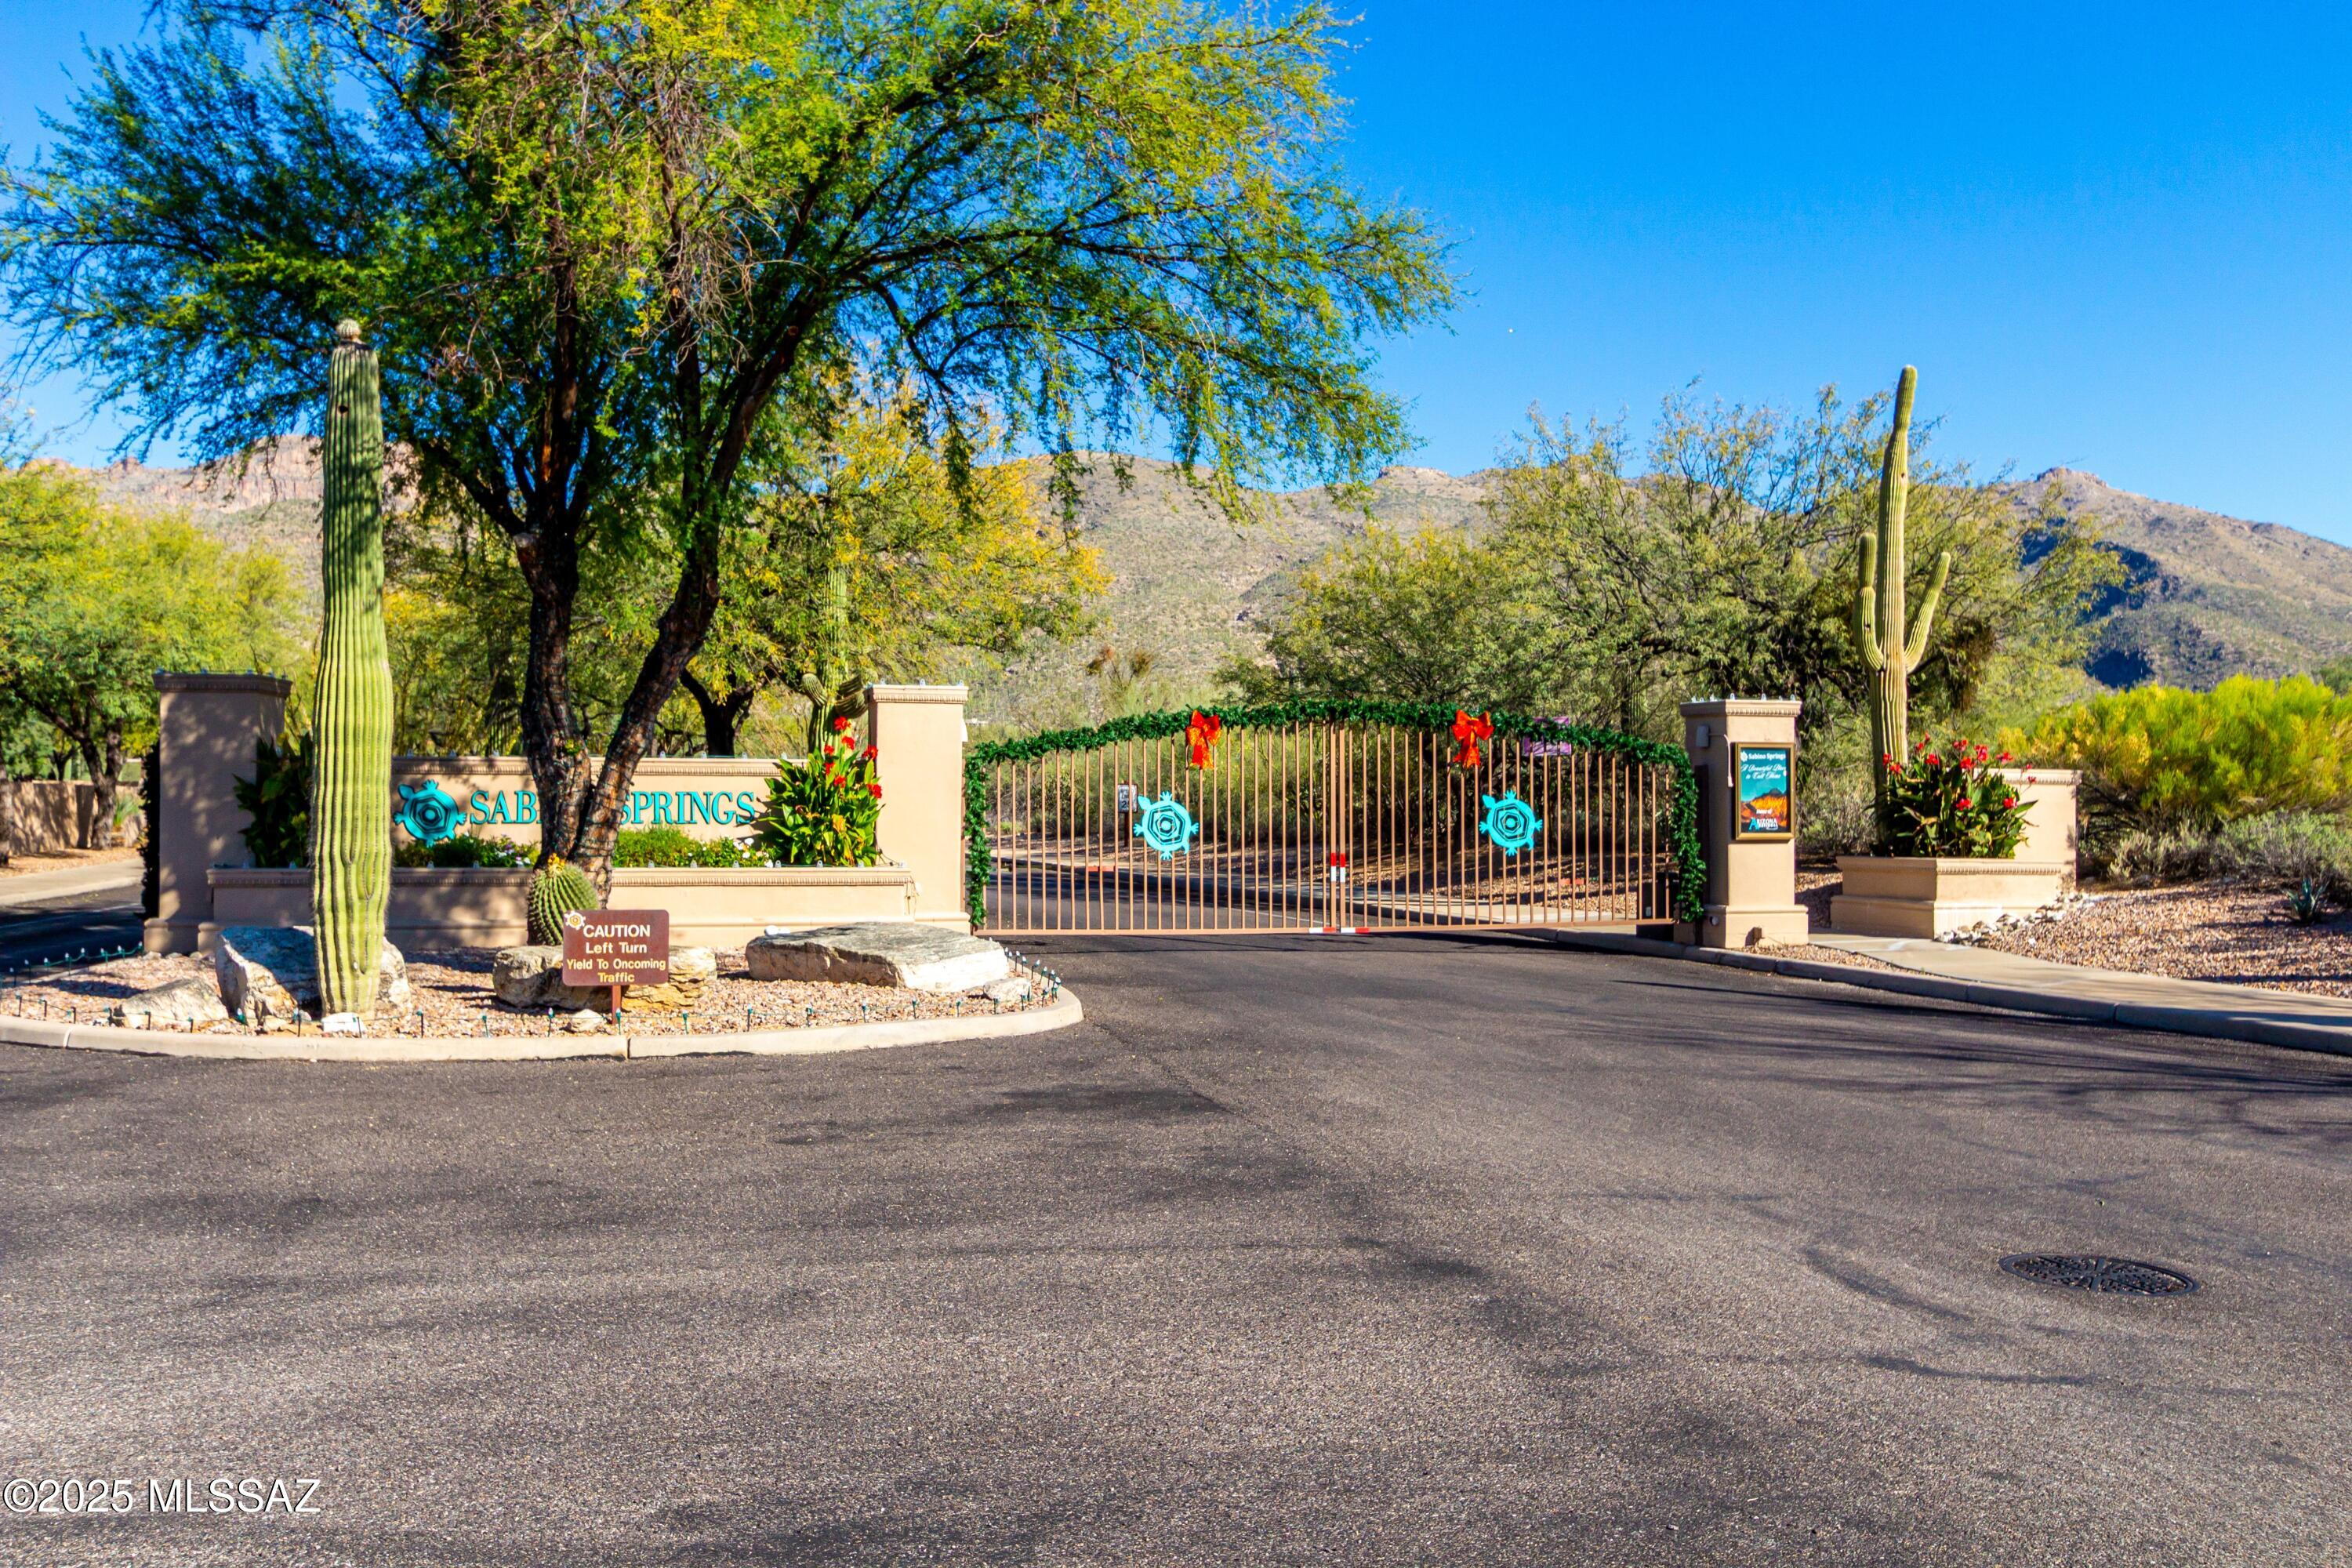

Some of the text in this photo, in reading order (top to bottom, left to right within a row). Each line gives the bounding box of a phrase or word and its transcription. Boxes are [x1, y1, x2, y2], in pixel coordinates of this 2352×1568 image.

[583, 924, 651, 938] CAUTION
[586, 942, 647, 954] Left Turn
[567, 958, 666, 971] Yield To Oncoming
[597, 972, 635, 982] Traffic
